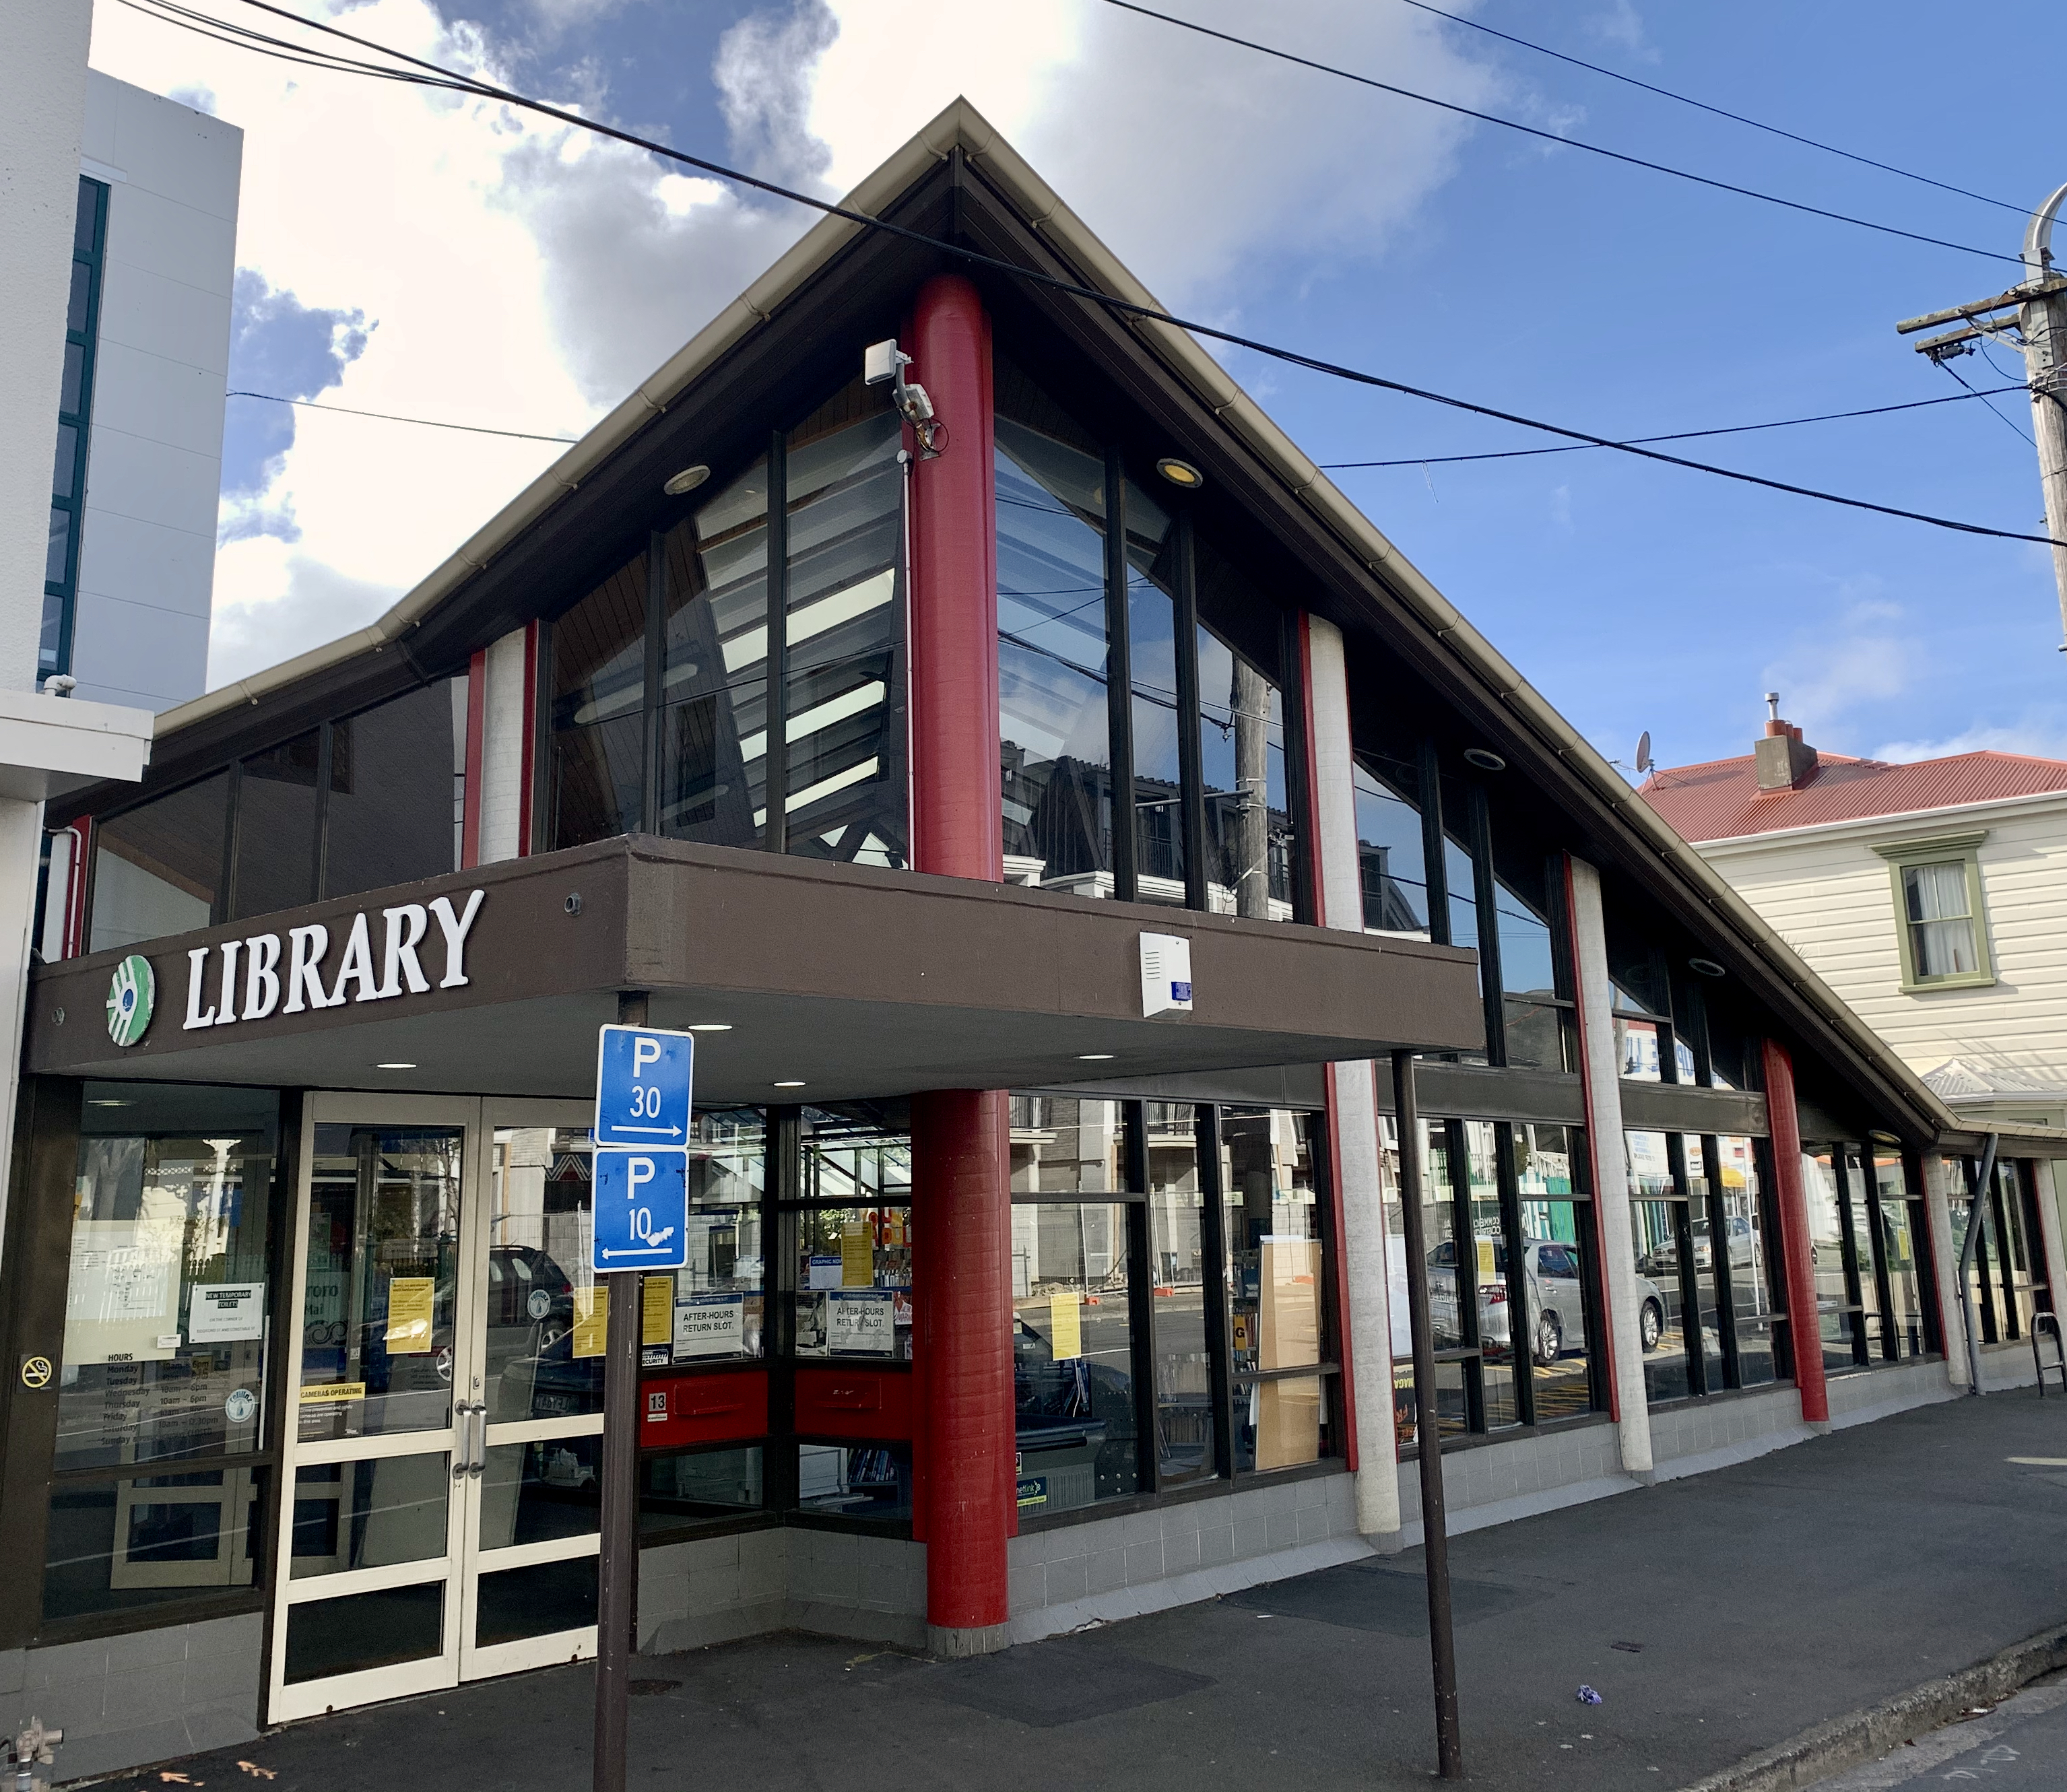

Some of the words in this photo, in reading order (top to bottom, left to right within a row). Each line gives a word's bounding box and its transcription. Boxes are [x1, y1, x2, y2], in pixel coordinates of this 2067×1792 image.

[183, 889, 485, 1030] LIBRARY
[633, 1036, 661, 1077] P
[629, 1085, 661, 1119] 30
[627, 1157, 656, 1200] P
[628, 1207, 653, 1240] 10
[683, 1310, 734, 1321] AFTER-HOURS
[682, 1323, 712, 1333] RETURN
[713, 1321, 734, 1331] SLOT.
[836, 1318, 864, 1327] RETUR
[1235, 1327, 1245, 1338] G
[108, 1352, 133, 1362] HOURS
[107, 1364, 139, 1374] Monday
[106, 1376, 138, 1386] Tuesday
[105, 1387, 150, 1397] Wednesday
[300, 1389, 329, 1399] CAMERAS
[330, 1387, 362, 1396] OPERATING
[104, 1399, 141, 1409] Thursday
[190, 1395, 207, 1404] 6pm
[651, 1395, 665, 1409] 13
